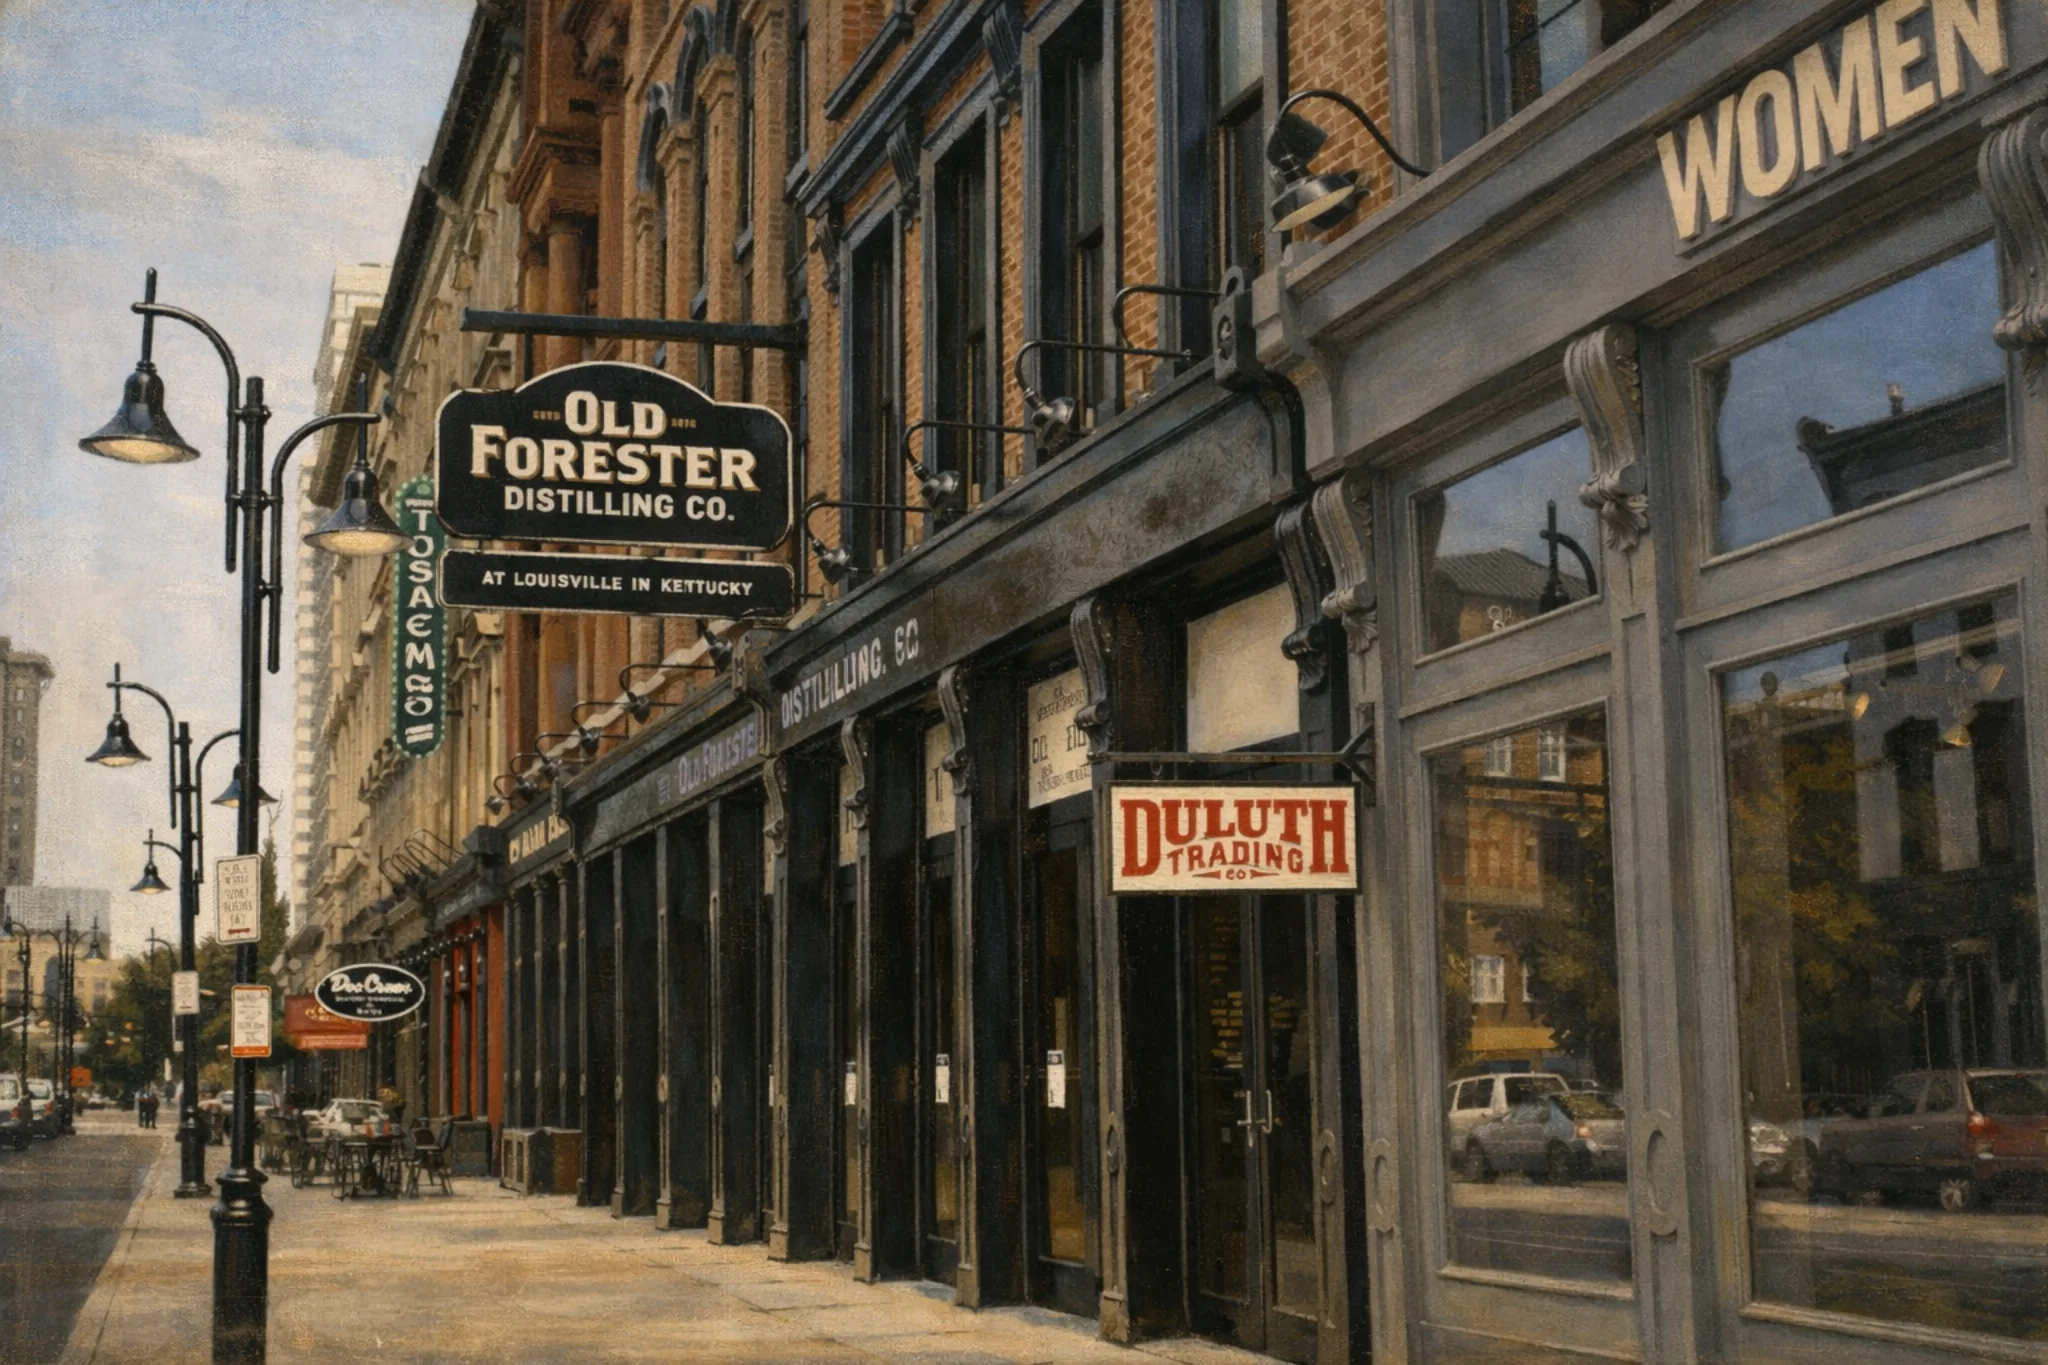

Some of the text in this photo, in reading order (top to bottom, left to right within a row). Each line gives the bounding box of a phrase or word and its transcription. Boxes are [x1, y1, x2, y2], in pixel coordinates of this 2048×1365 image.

[1656, 0, 2010, 241] WOMEN
[564, 390, 667, 439] OLD
[470, 424, 761, 492] FORESTER
[504, 486, 735, 521] DISTILLING CO.
[481, 571, 505, 585] AT
[514, 572, 623, 590] LOUISVILLE
[632, 578, 651, 592] IN
[1120, 799, 1349, 877] DULUTH
[1166, 841, 1304, 875] TRADING
[1225, 868, 1246, 881] CO
